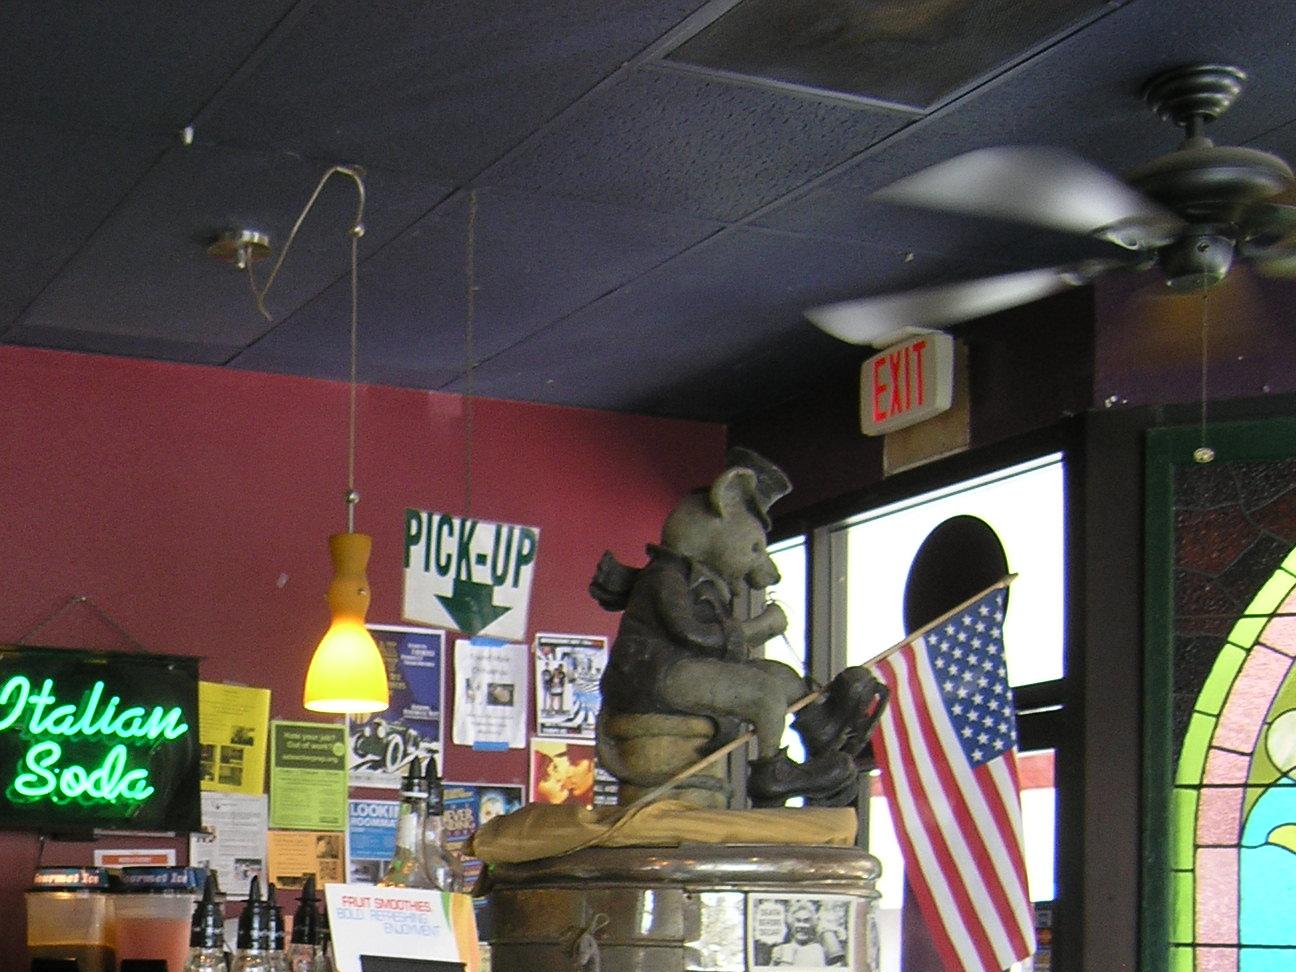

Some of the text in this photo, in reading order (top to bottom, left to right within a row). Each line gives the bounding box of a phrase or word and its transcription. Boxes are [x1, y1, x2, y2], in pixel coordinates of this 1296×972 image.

[873, 340, 927, 424] EXIT
[404, 509, 537, 588] PICK-UP
[14, 740, 155, 800] Soda
[342, 896, 432, 912] FRUIT SMOOTHIES
